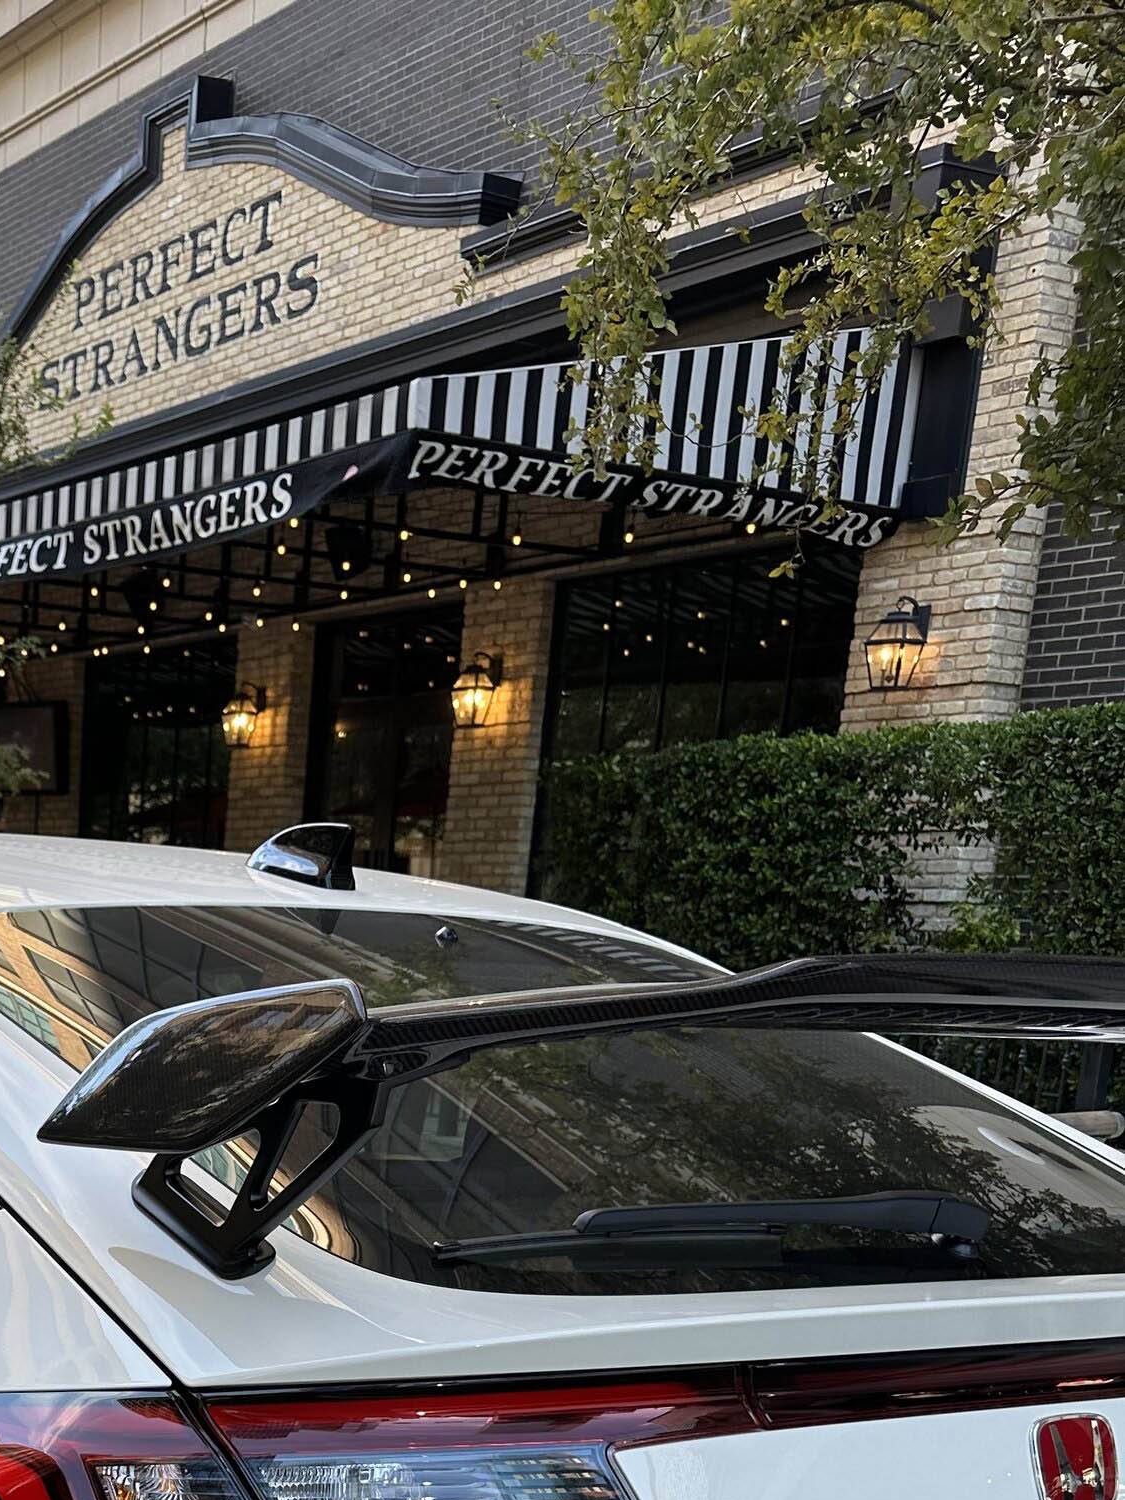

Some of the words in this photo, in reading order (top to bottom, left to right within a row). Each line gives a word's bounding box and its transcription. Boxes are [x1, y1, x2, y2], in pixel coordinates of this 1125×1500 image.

[73, 190, 282, 331] PERFECT
[40, 254, 320, 406] STRANGERS
[83, 473, 293, 565] STRANGERS
[408, 440, 634, 501] PERFECT
